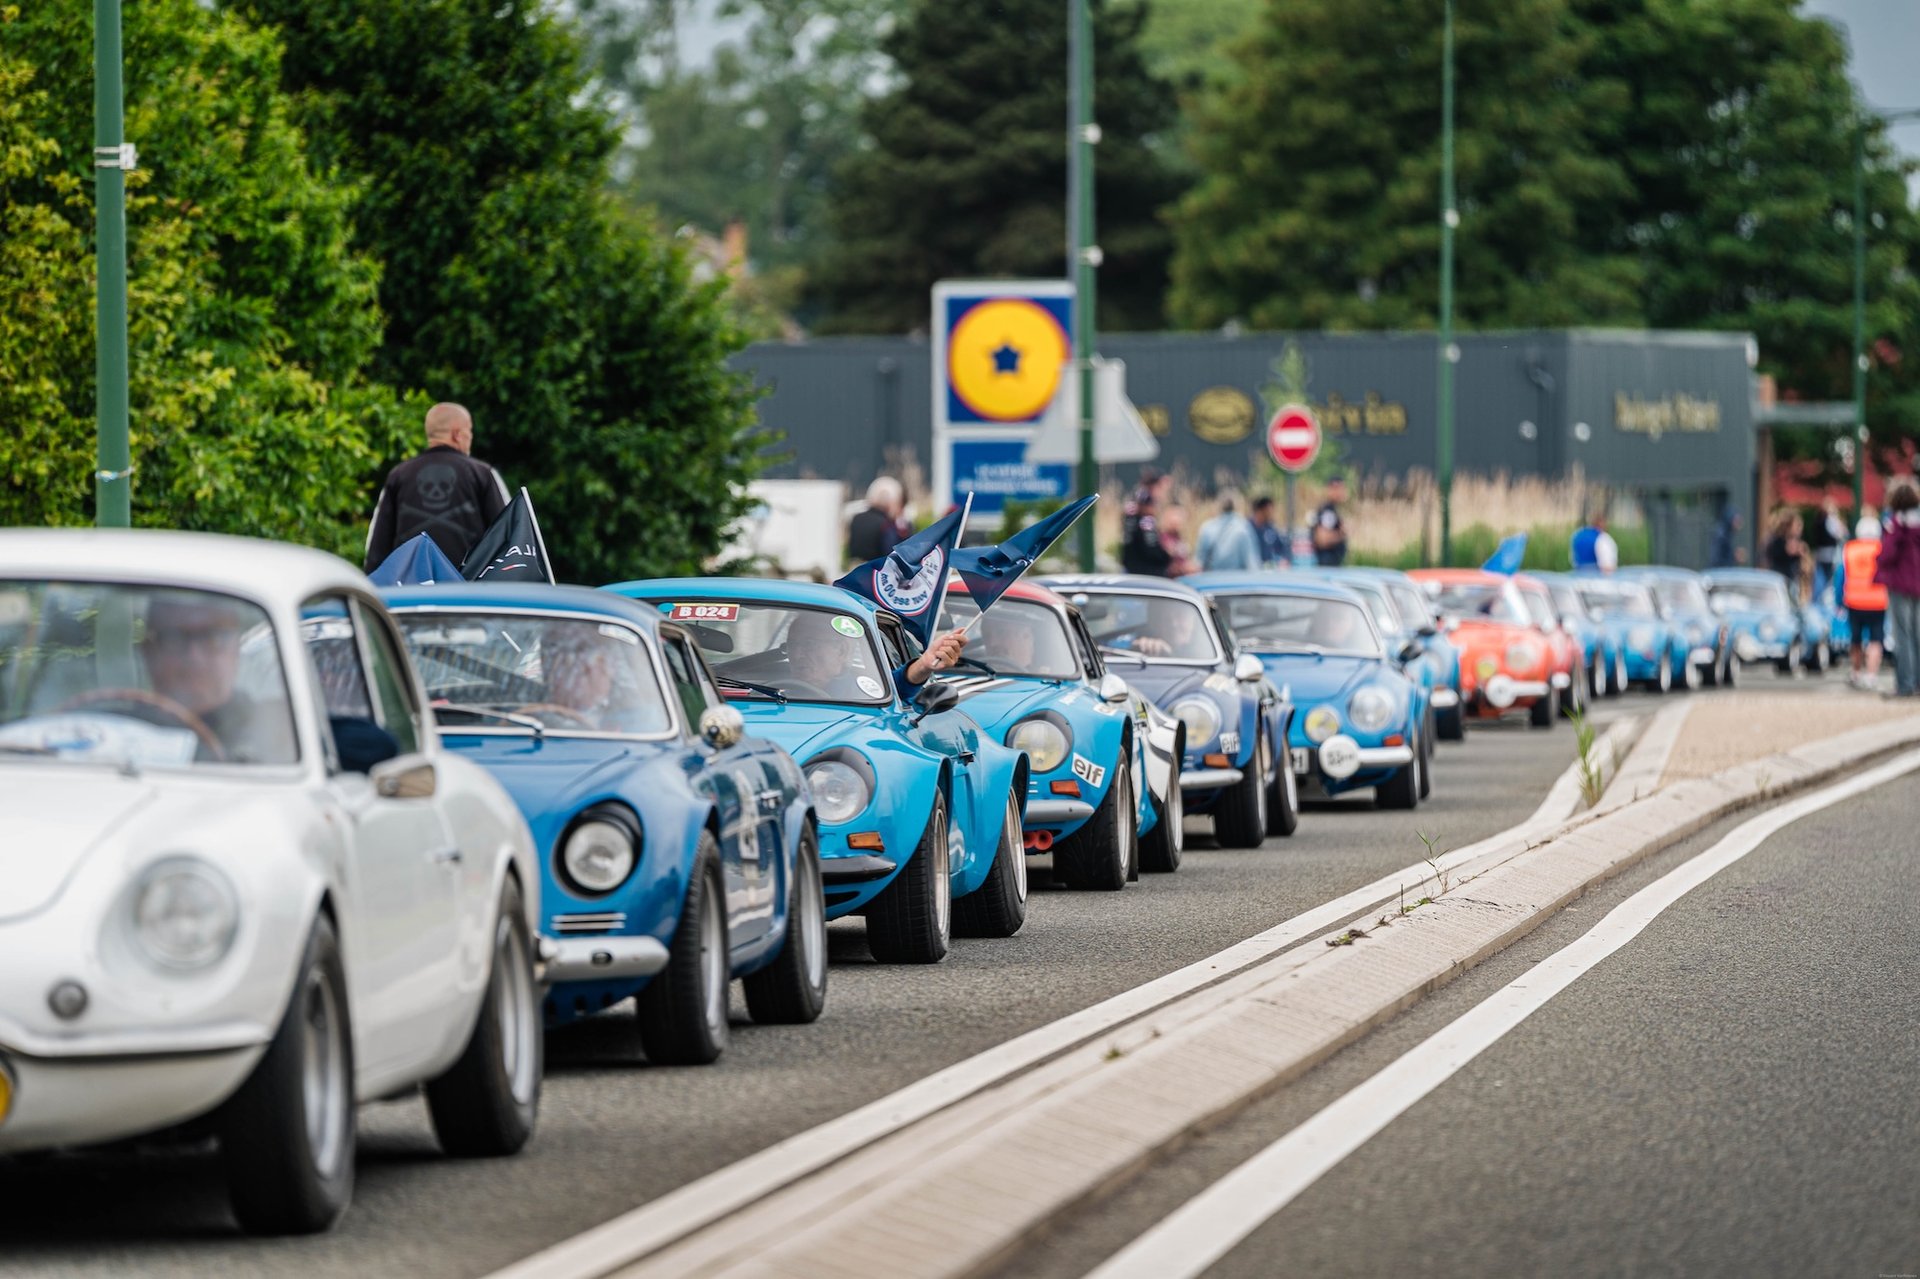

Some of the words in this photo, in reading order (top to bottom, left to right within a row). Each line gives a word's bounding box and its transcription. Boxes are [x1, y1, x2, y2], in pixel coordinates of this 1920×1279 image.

[679, 606, 692, 617] B
[695, 606, 729, 617] 024
[1074, 759, 1102, 784] elf
